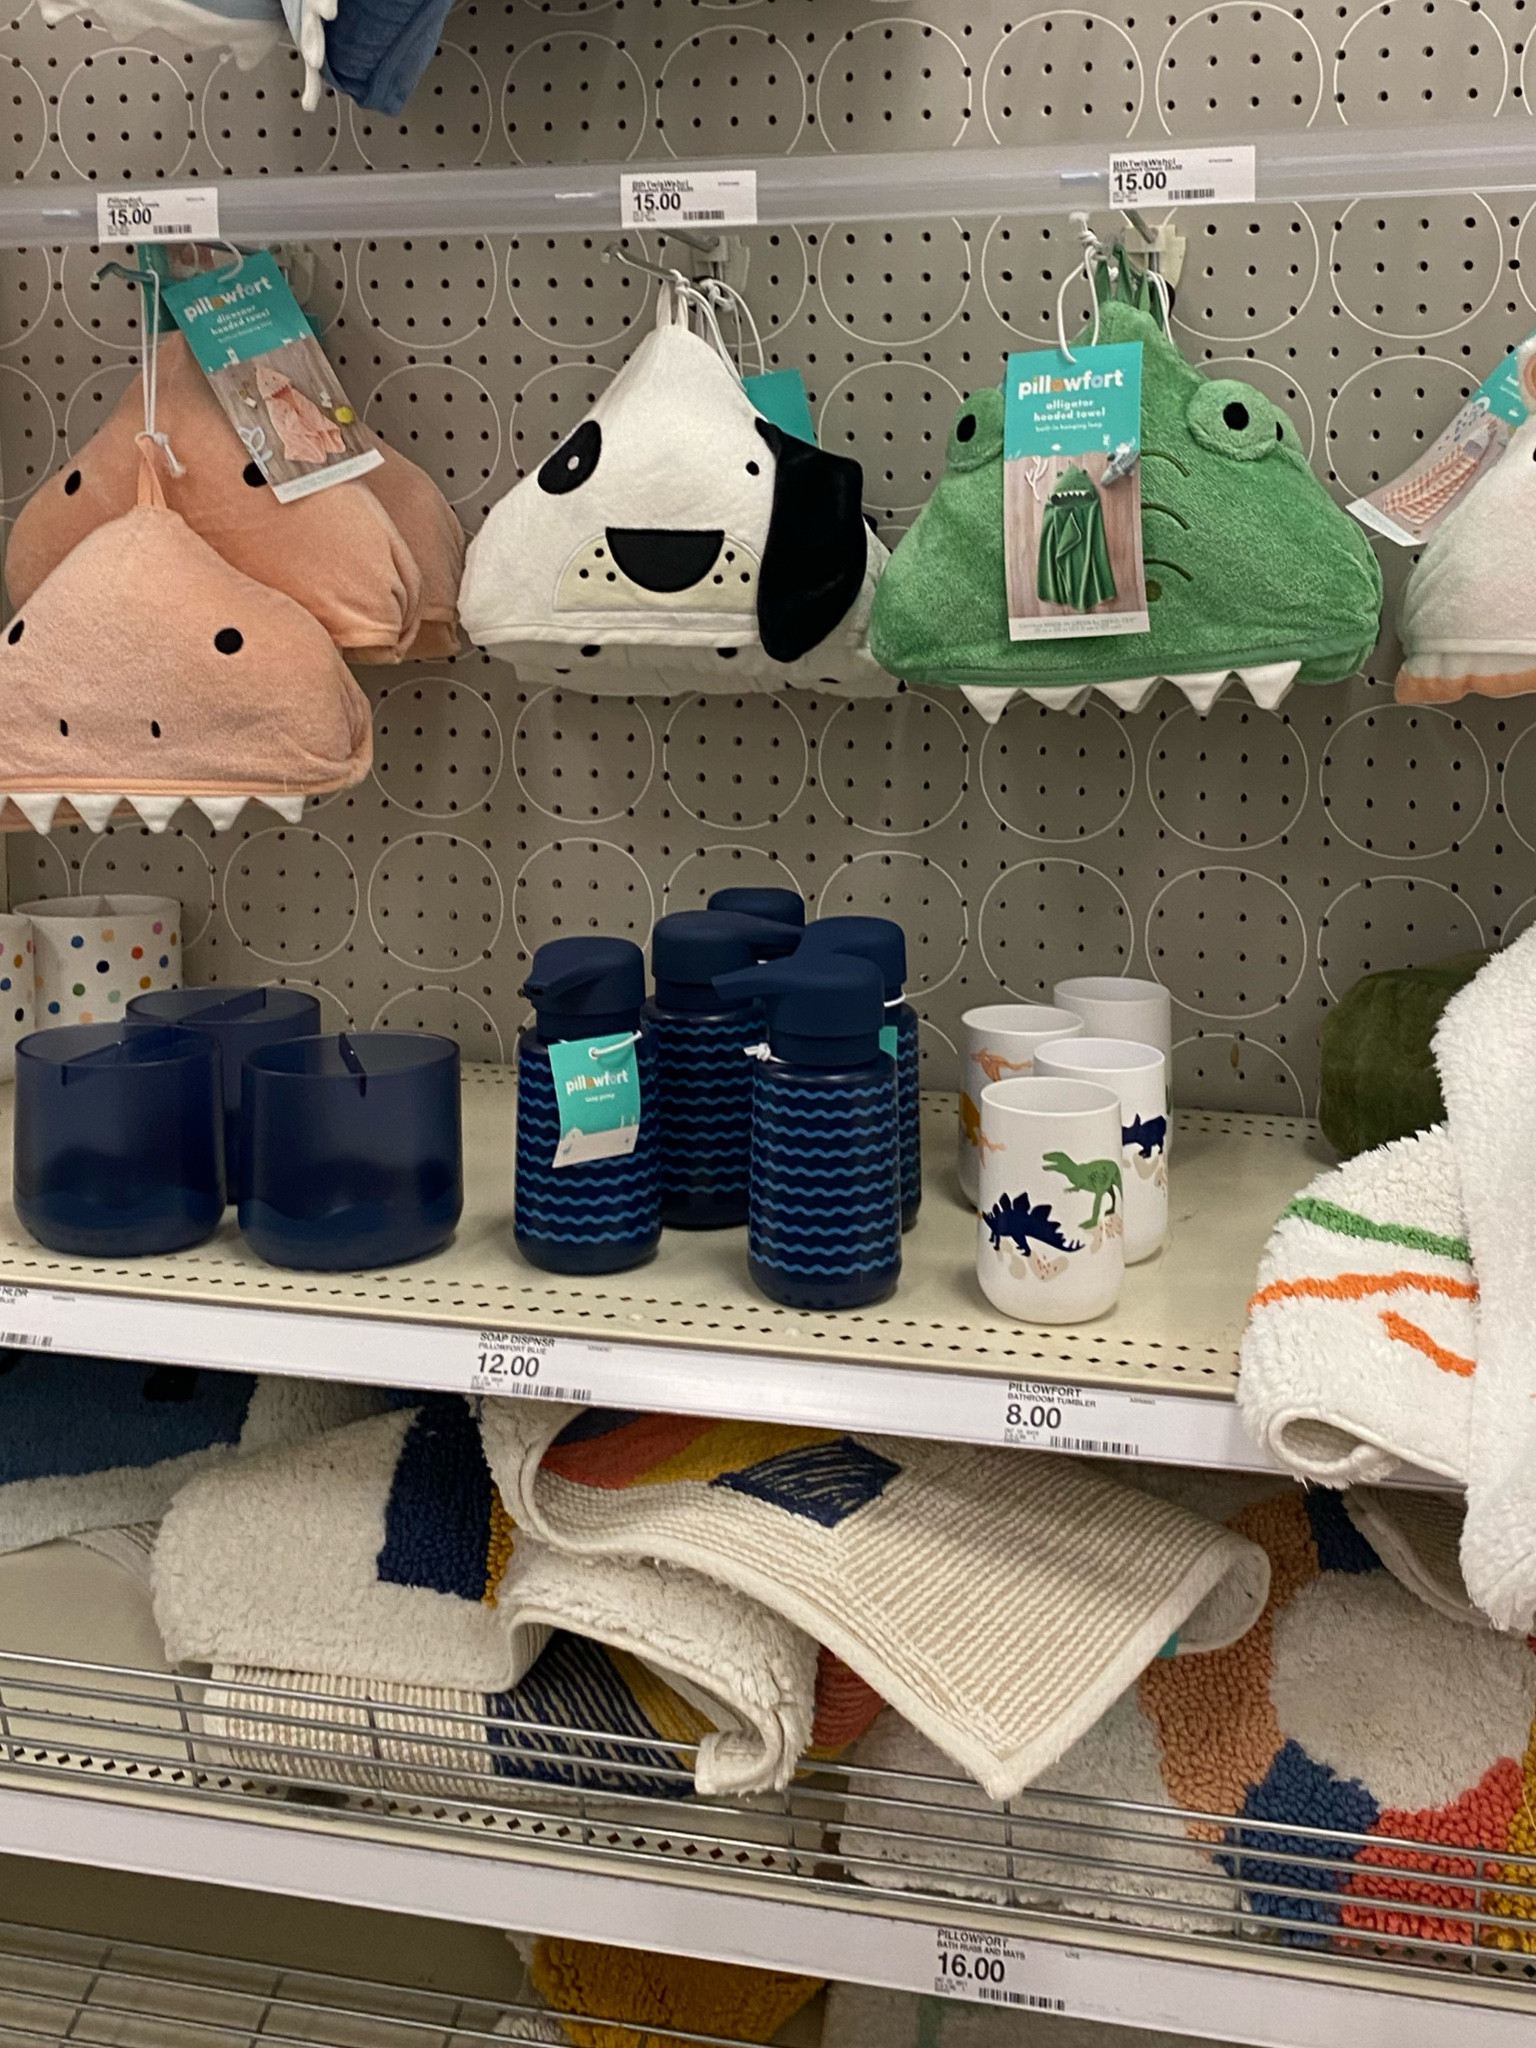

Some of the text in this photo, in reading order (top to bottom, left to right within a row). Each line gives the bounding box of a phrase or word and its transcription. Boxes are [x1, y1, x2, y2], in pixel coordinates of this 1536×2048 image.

[1114, 172, 1167, 191] 15.00
[633, 193, 681, 211] 15.00
[109, 208, 152, 226] 15.00
[184, 276, 272, 323] pillowfort
[1018, 369, 1124, 400] pillowfort
[1033, 406, 1106, 422] hooded towel
[1045, 399, 1094, 411] alligator
[565, 1069, 628, 1096] pillowfort
[480, 1331, 555, 1347] SOAP DISPNSR
[478, 1352, 540, 1377] 12.00
[1008, 1382, 1082, 1397] PILLOWFORT
[1007, 1393, 1096, 1408] BATHROOM TUMBLER
[1006, 1403, 1061, 1428] 8.00
[937, 1929, 1009, 1948] PILLOWFORT
[937, 1940, 1026, 1960] BATH RUGS AND MATS
[938, 1952, 1005, 1983] 16.00
